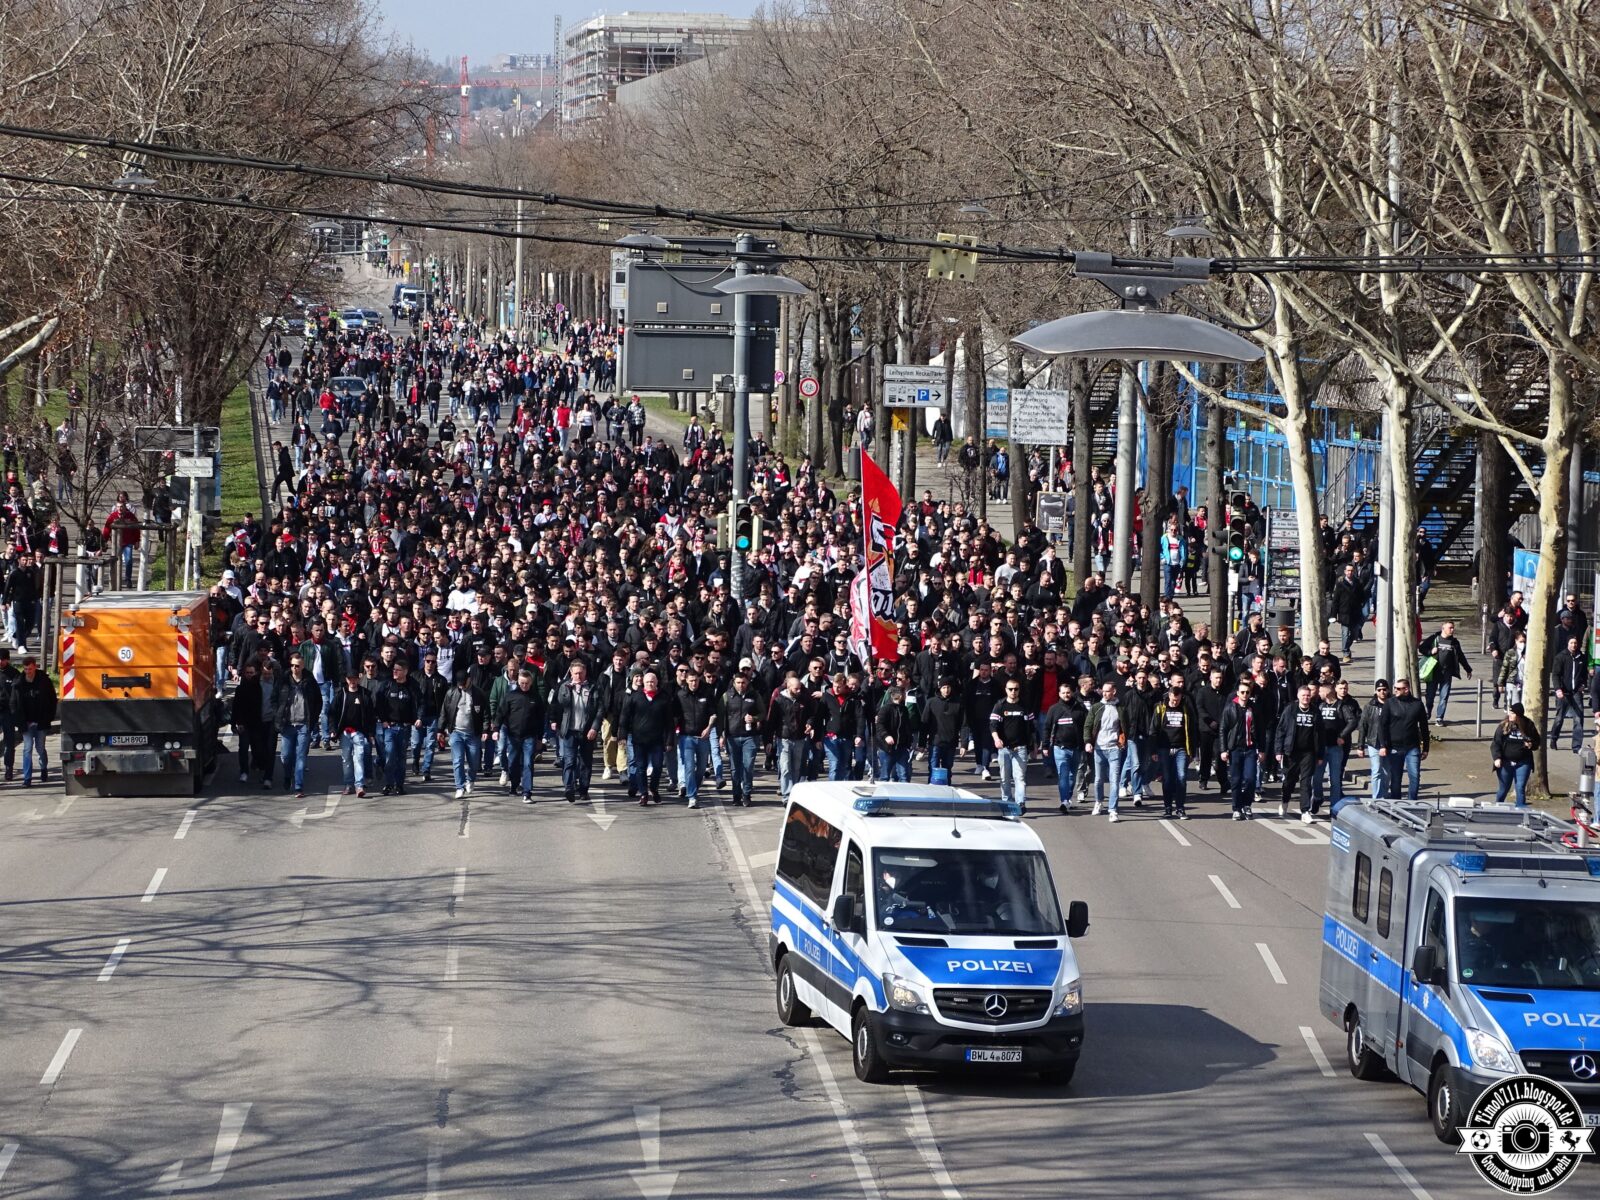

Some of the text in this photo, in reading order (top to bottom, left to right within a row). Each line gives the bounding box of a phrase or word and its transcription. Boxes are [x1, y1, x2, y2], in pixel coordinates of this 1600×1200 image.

[920, 390, 927, 400] P
[120, 649, 131, 659] 50
[112, 736, 117, 744] S
[1335, 926, 1359, 959] POLIZEI
[804, 938, 821, 962] POLIZEI
[946, 960, 1034, 974] POLIZEI
[1523, 1012, 1600, 1027] POLIZ
[971, 1051, 988, 1061] BWL
[1001, 1051, 1021, 1061] 8073
